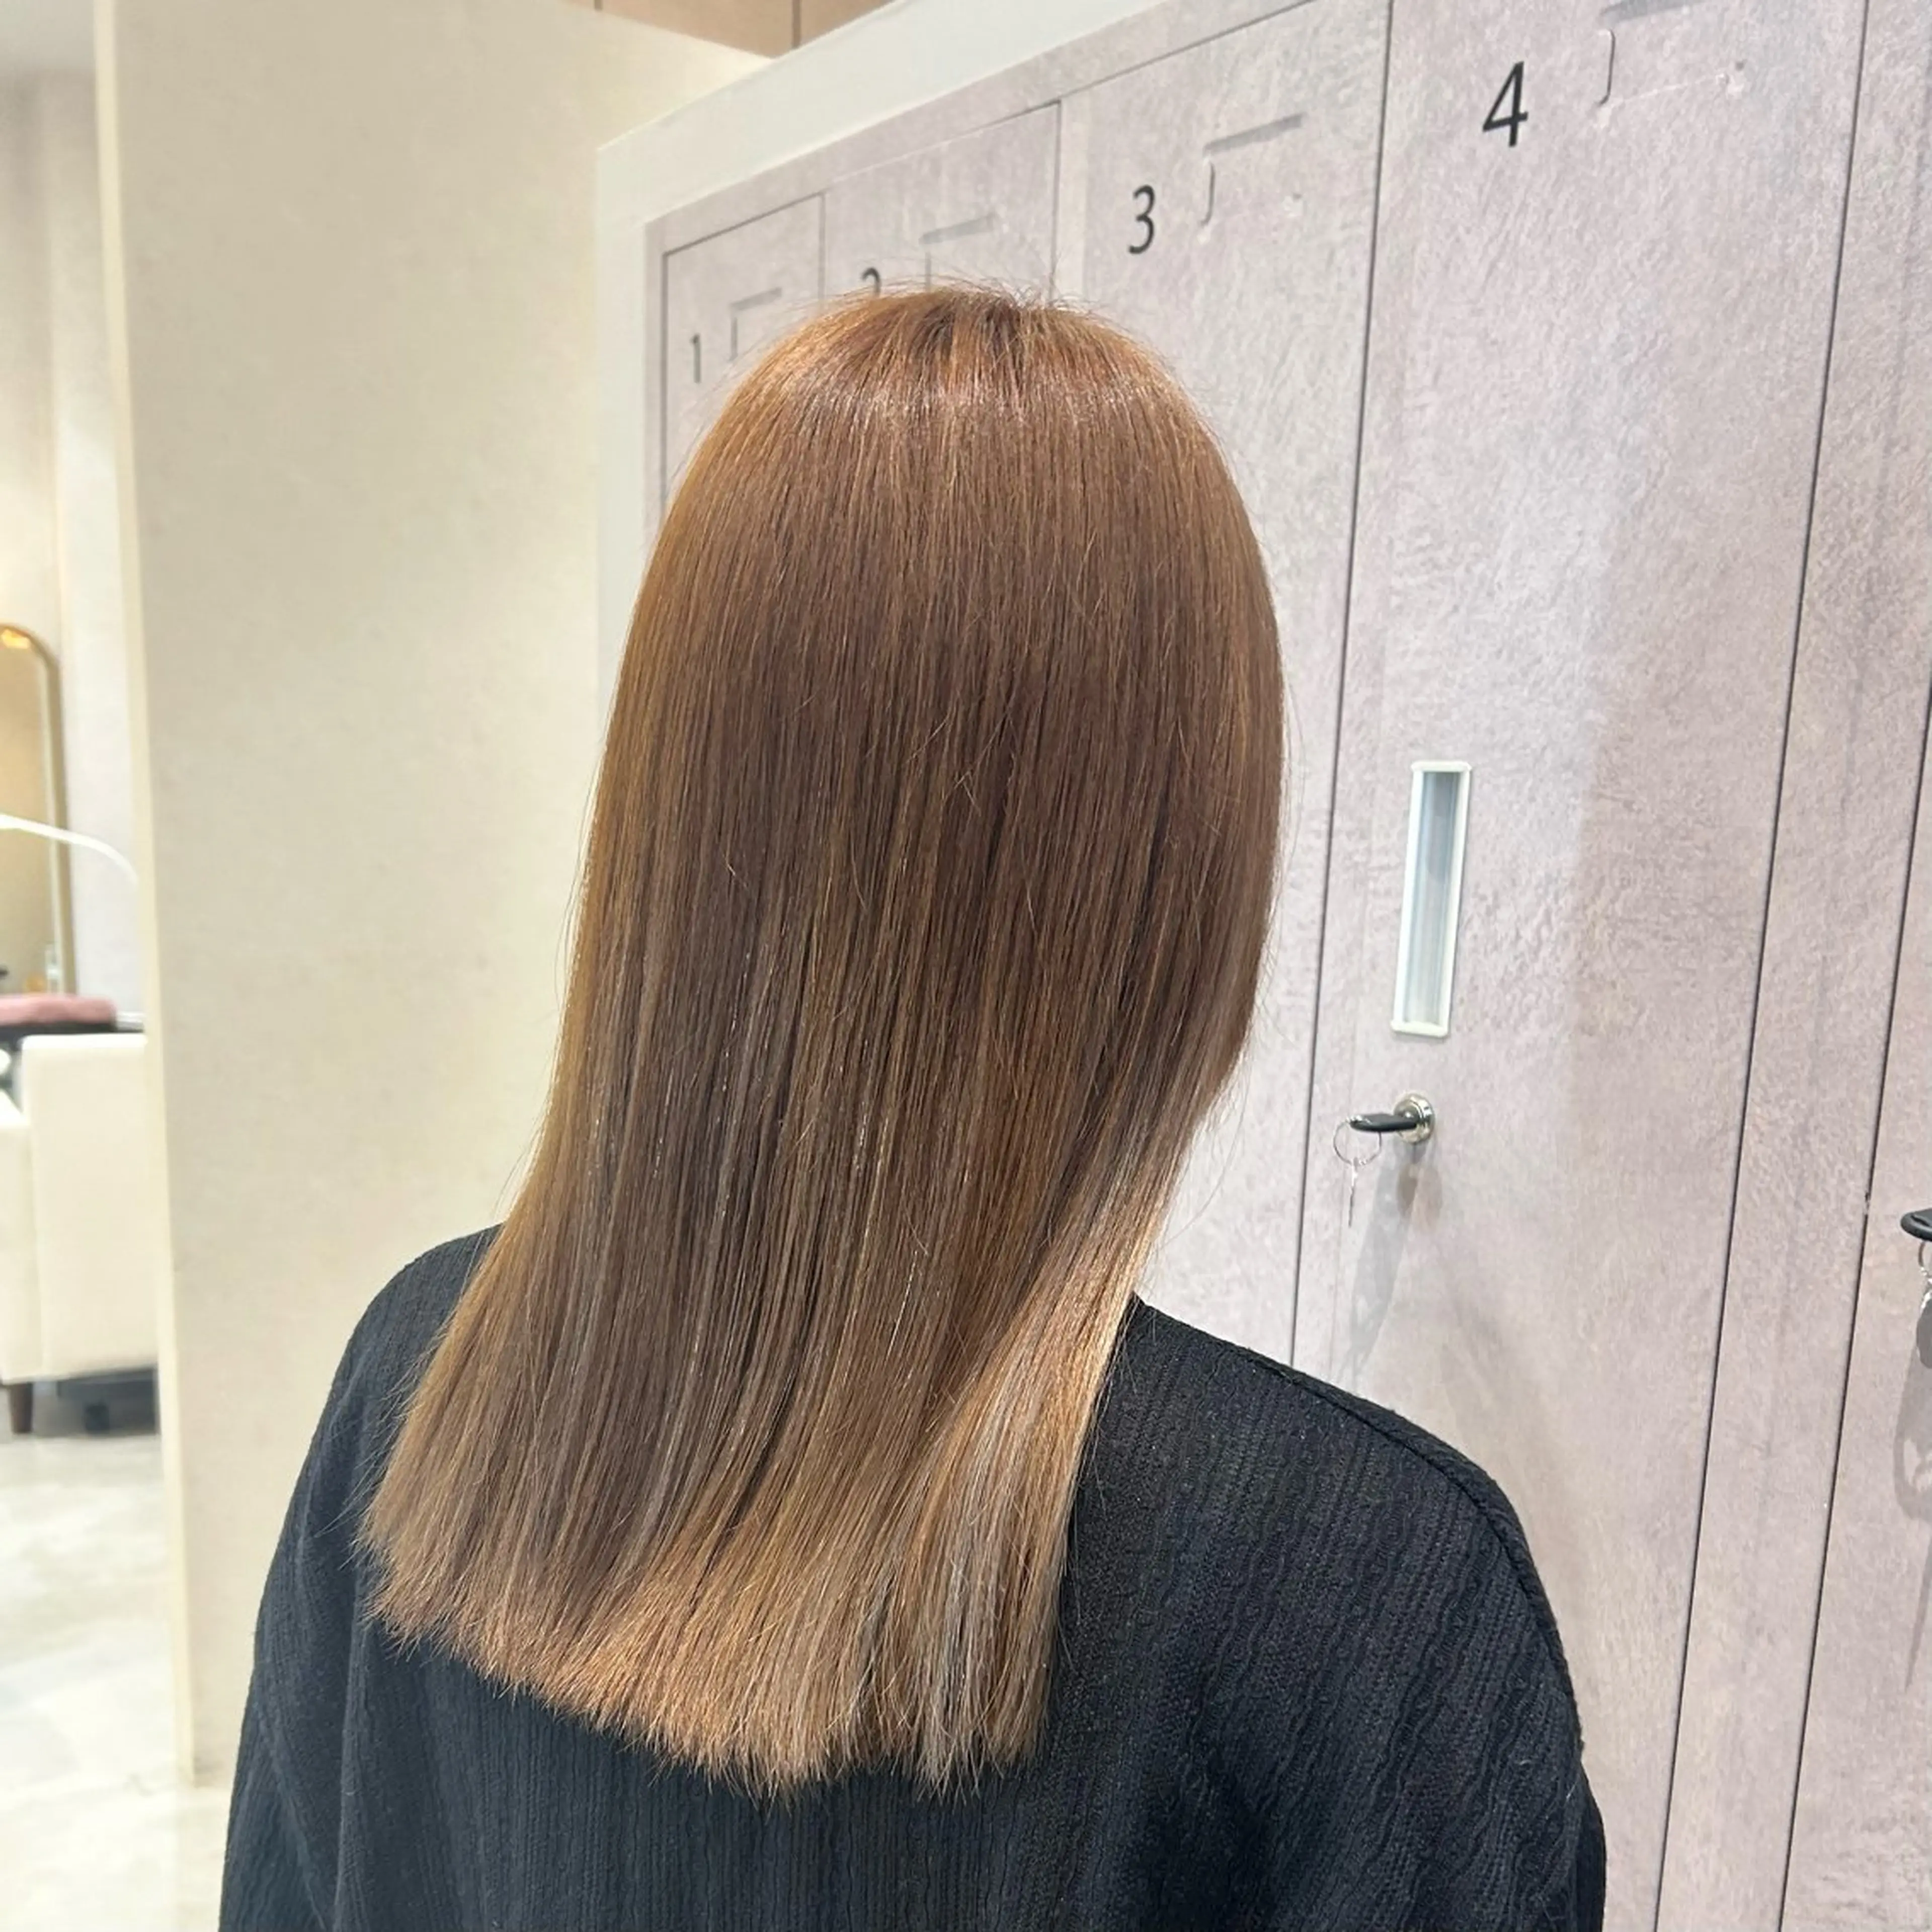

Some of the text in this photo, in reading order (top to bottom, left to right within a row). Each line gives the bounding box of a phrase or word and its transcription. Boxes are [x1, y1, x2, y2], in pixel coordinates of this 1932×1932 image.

[1482, 61, 1528, 147] 4
[1129, 185, 1155, 255] 3
[689, 333, 701, 384] 1
